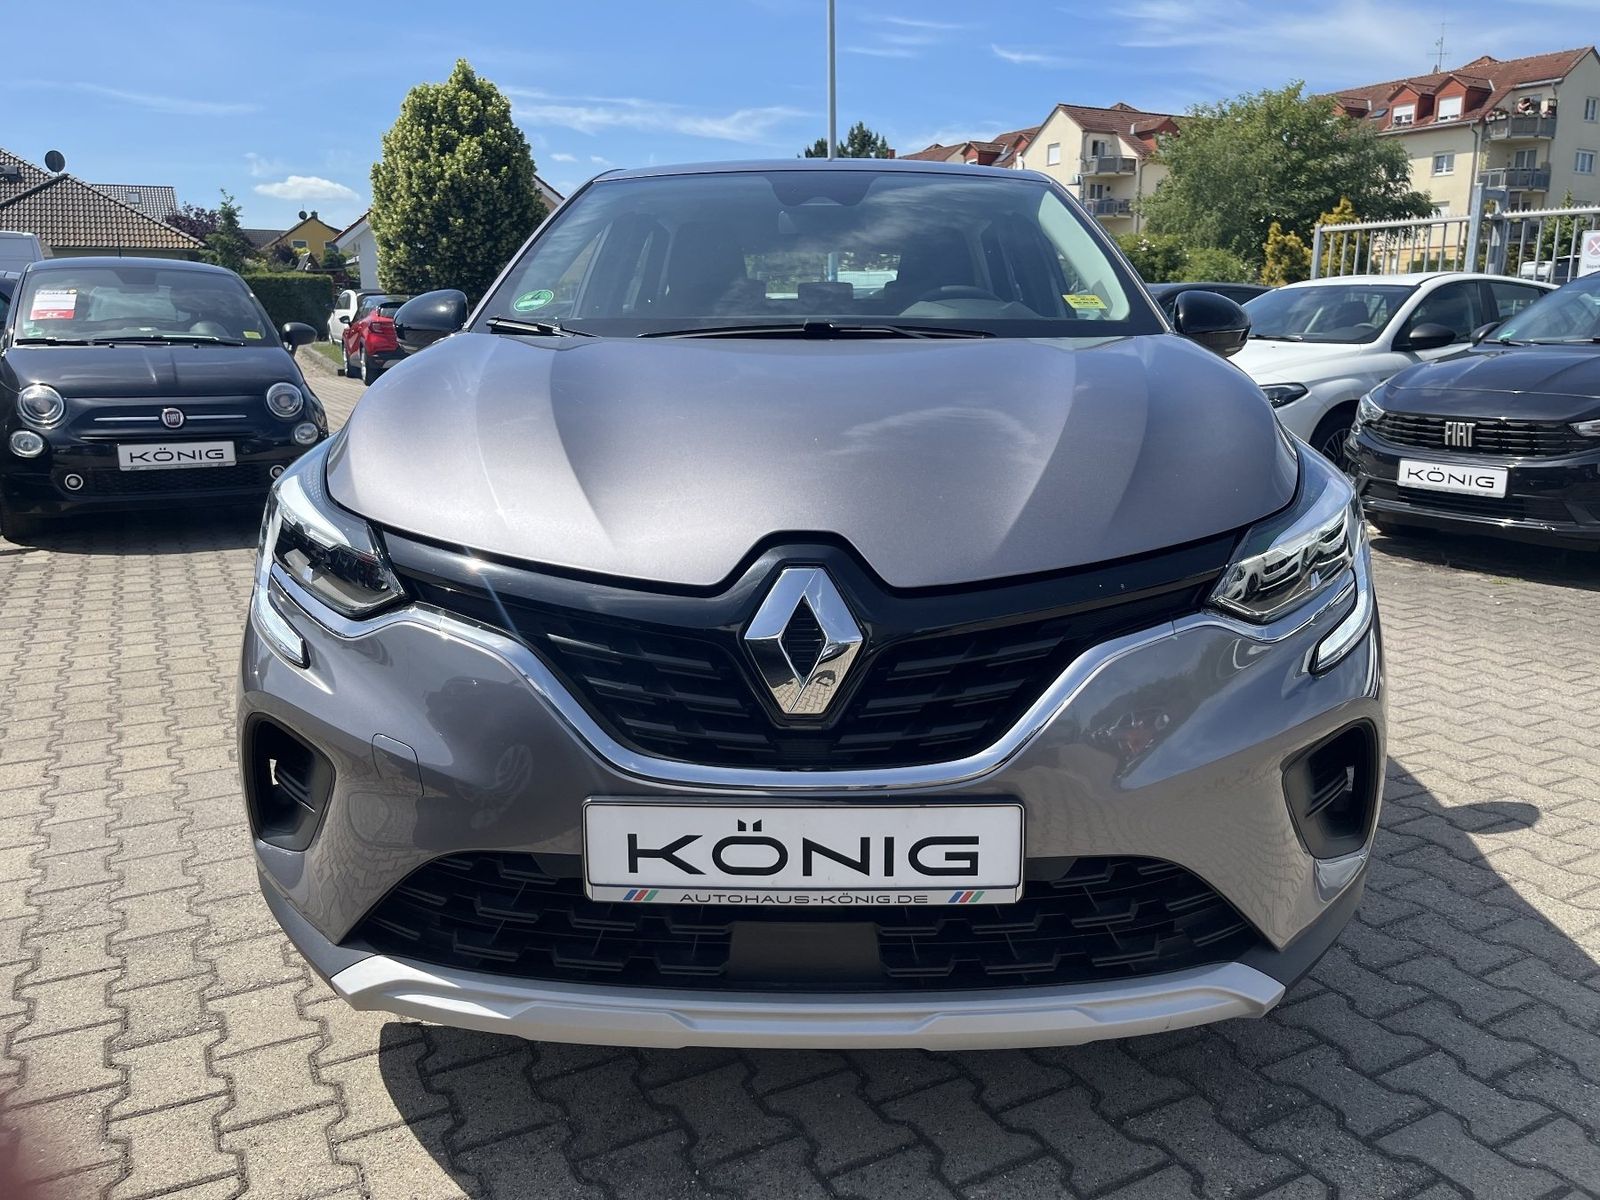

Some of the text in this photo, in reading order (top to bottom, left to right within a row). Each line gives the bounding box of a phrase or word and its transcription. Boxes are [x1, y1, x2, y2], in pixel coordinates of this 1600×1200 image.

[166, 413, 179, 423] FIAT
[1444, 421, 1476, 447] FIAT
[129, 447, 224, 463] KÖNIG
[1407, 466, 1495, 489] KÖNIG
[627, 818, 980, 877] KÖNIG
[679, 892, 928, 904] AUTOHAUS-KÖNIG.DE
